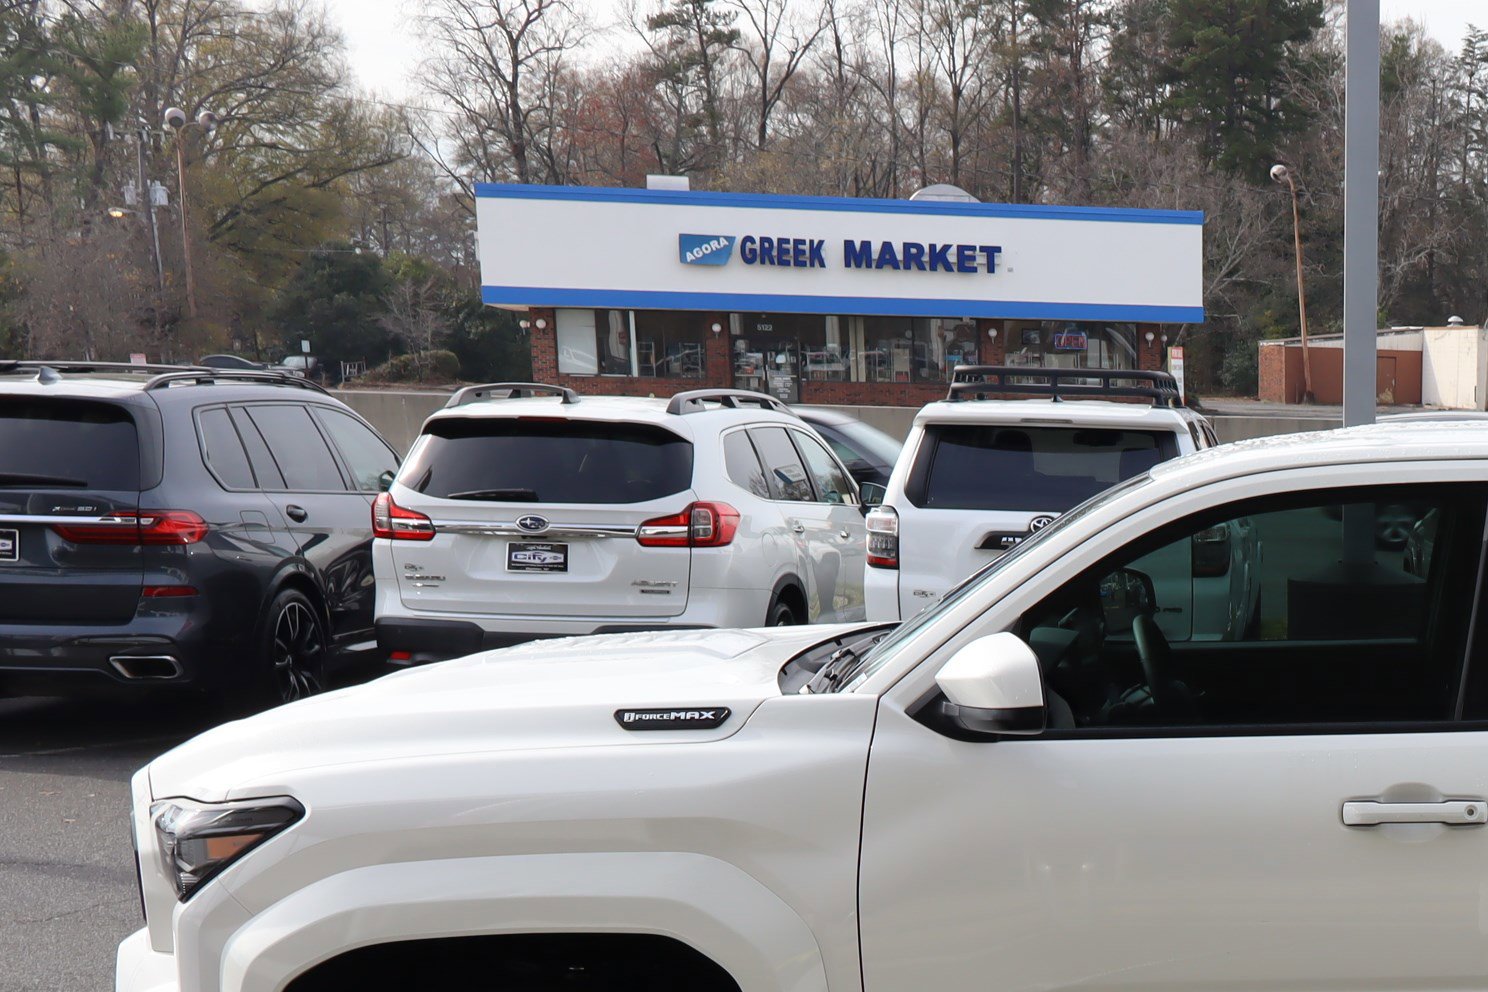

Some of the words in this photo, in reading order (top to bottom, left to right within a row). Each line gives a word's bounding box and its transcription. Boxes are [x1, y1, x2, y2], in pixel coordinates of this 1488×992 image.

[685, 236, 729, 262] AGORA
[740, 235, 826, 269] GREEK
[843, 239, 1002, 274] MARKET
